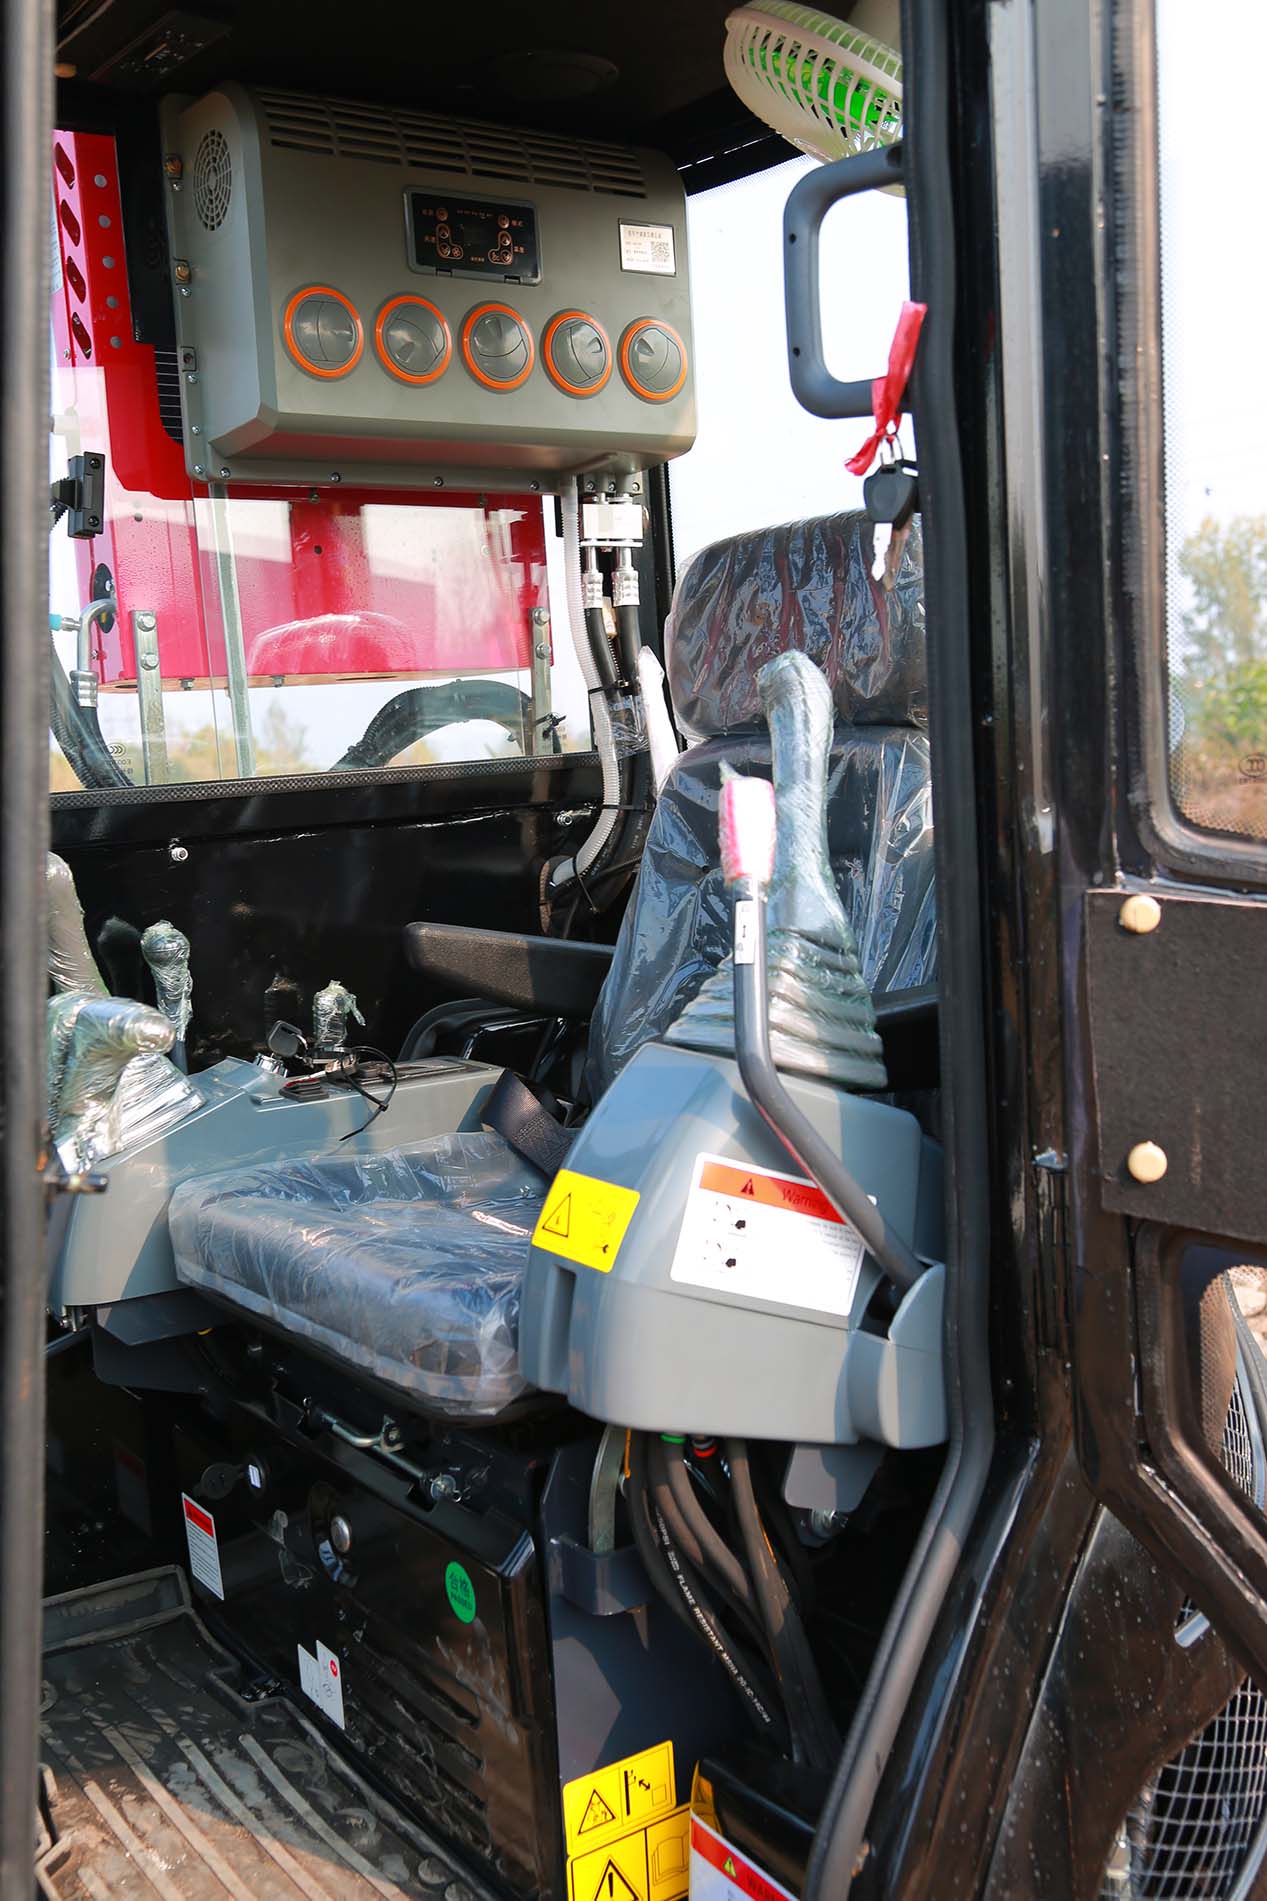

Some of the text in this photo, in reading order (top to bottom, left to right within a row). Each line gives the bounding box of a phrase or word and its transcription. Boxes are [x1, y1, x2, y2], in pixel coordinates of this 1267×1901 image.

[448, 1572, 471, 1599] 合格
[677, 1574, 696, 1606] FLAME
[694, 1606, 724, 1652] RESISTANT
